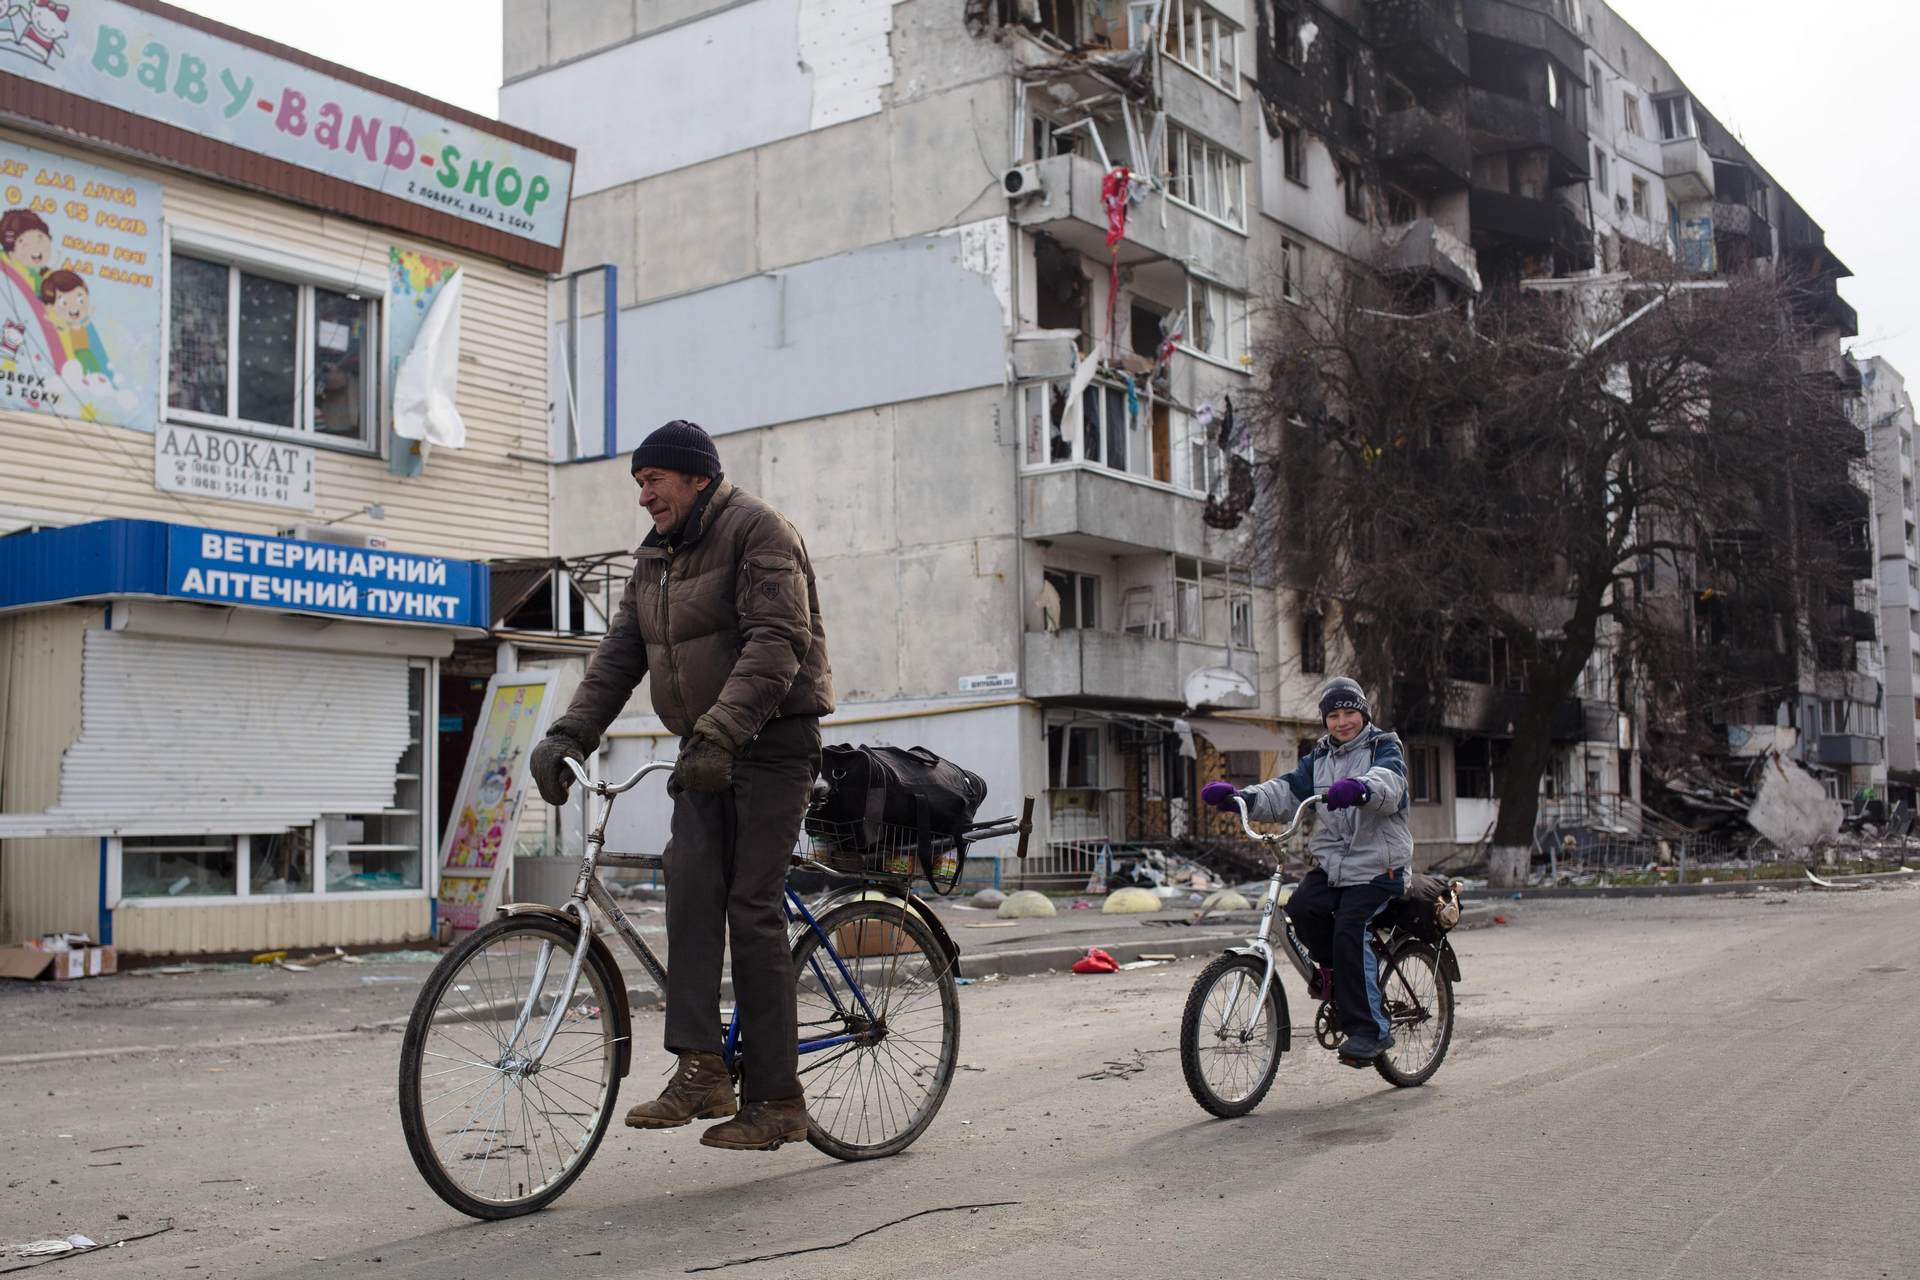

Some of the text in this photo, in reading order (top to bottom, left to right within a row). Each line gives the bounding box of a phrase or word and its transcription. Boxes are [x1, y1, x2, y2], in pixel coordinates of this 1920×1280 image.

[0, 159, 28, 178] ЯГ
[35, 168, 76, 191] ДЛЯ
[408, 181, 416, 193] 2
[30, 195, 57, 214] ДО
[64, 201, 88, 222] 15
[96, 211, 147, 236] РОКІВ
[161, 429, 298, 475] АДВОКАТ
[201, 534, 446, 586] ВЕТЕРИНАРНИЙ
[181, 567, 460, 619] АПТЕЧНИЙ ПУНКТ
